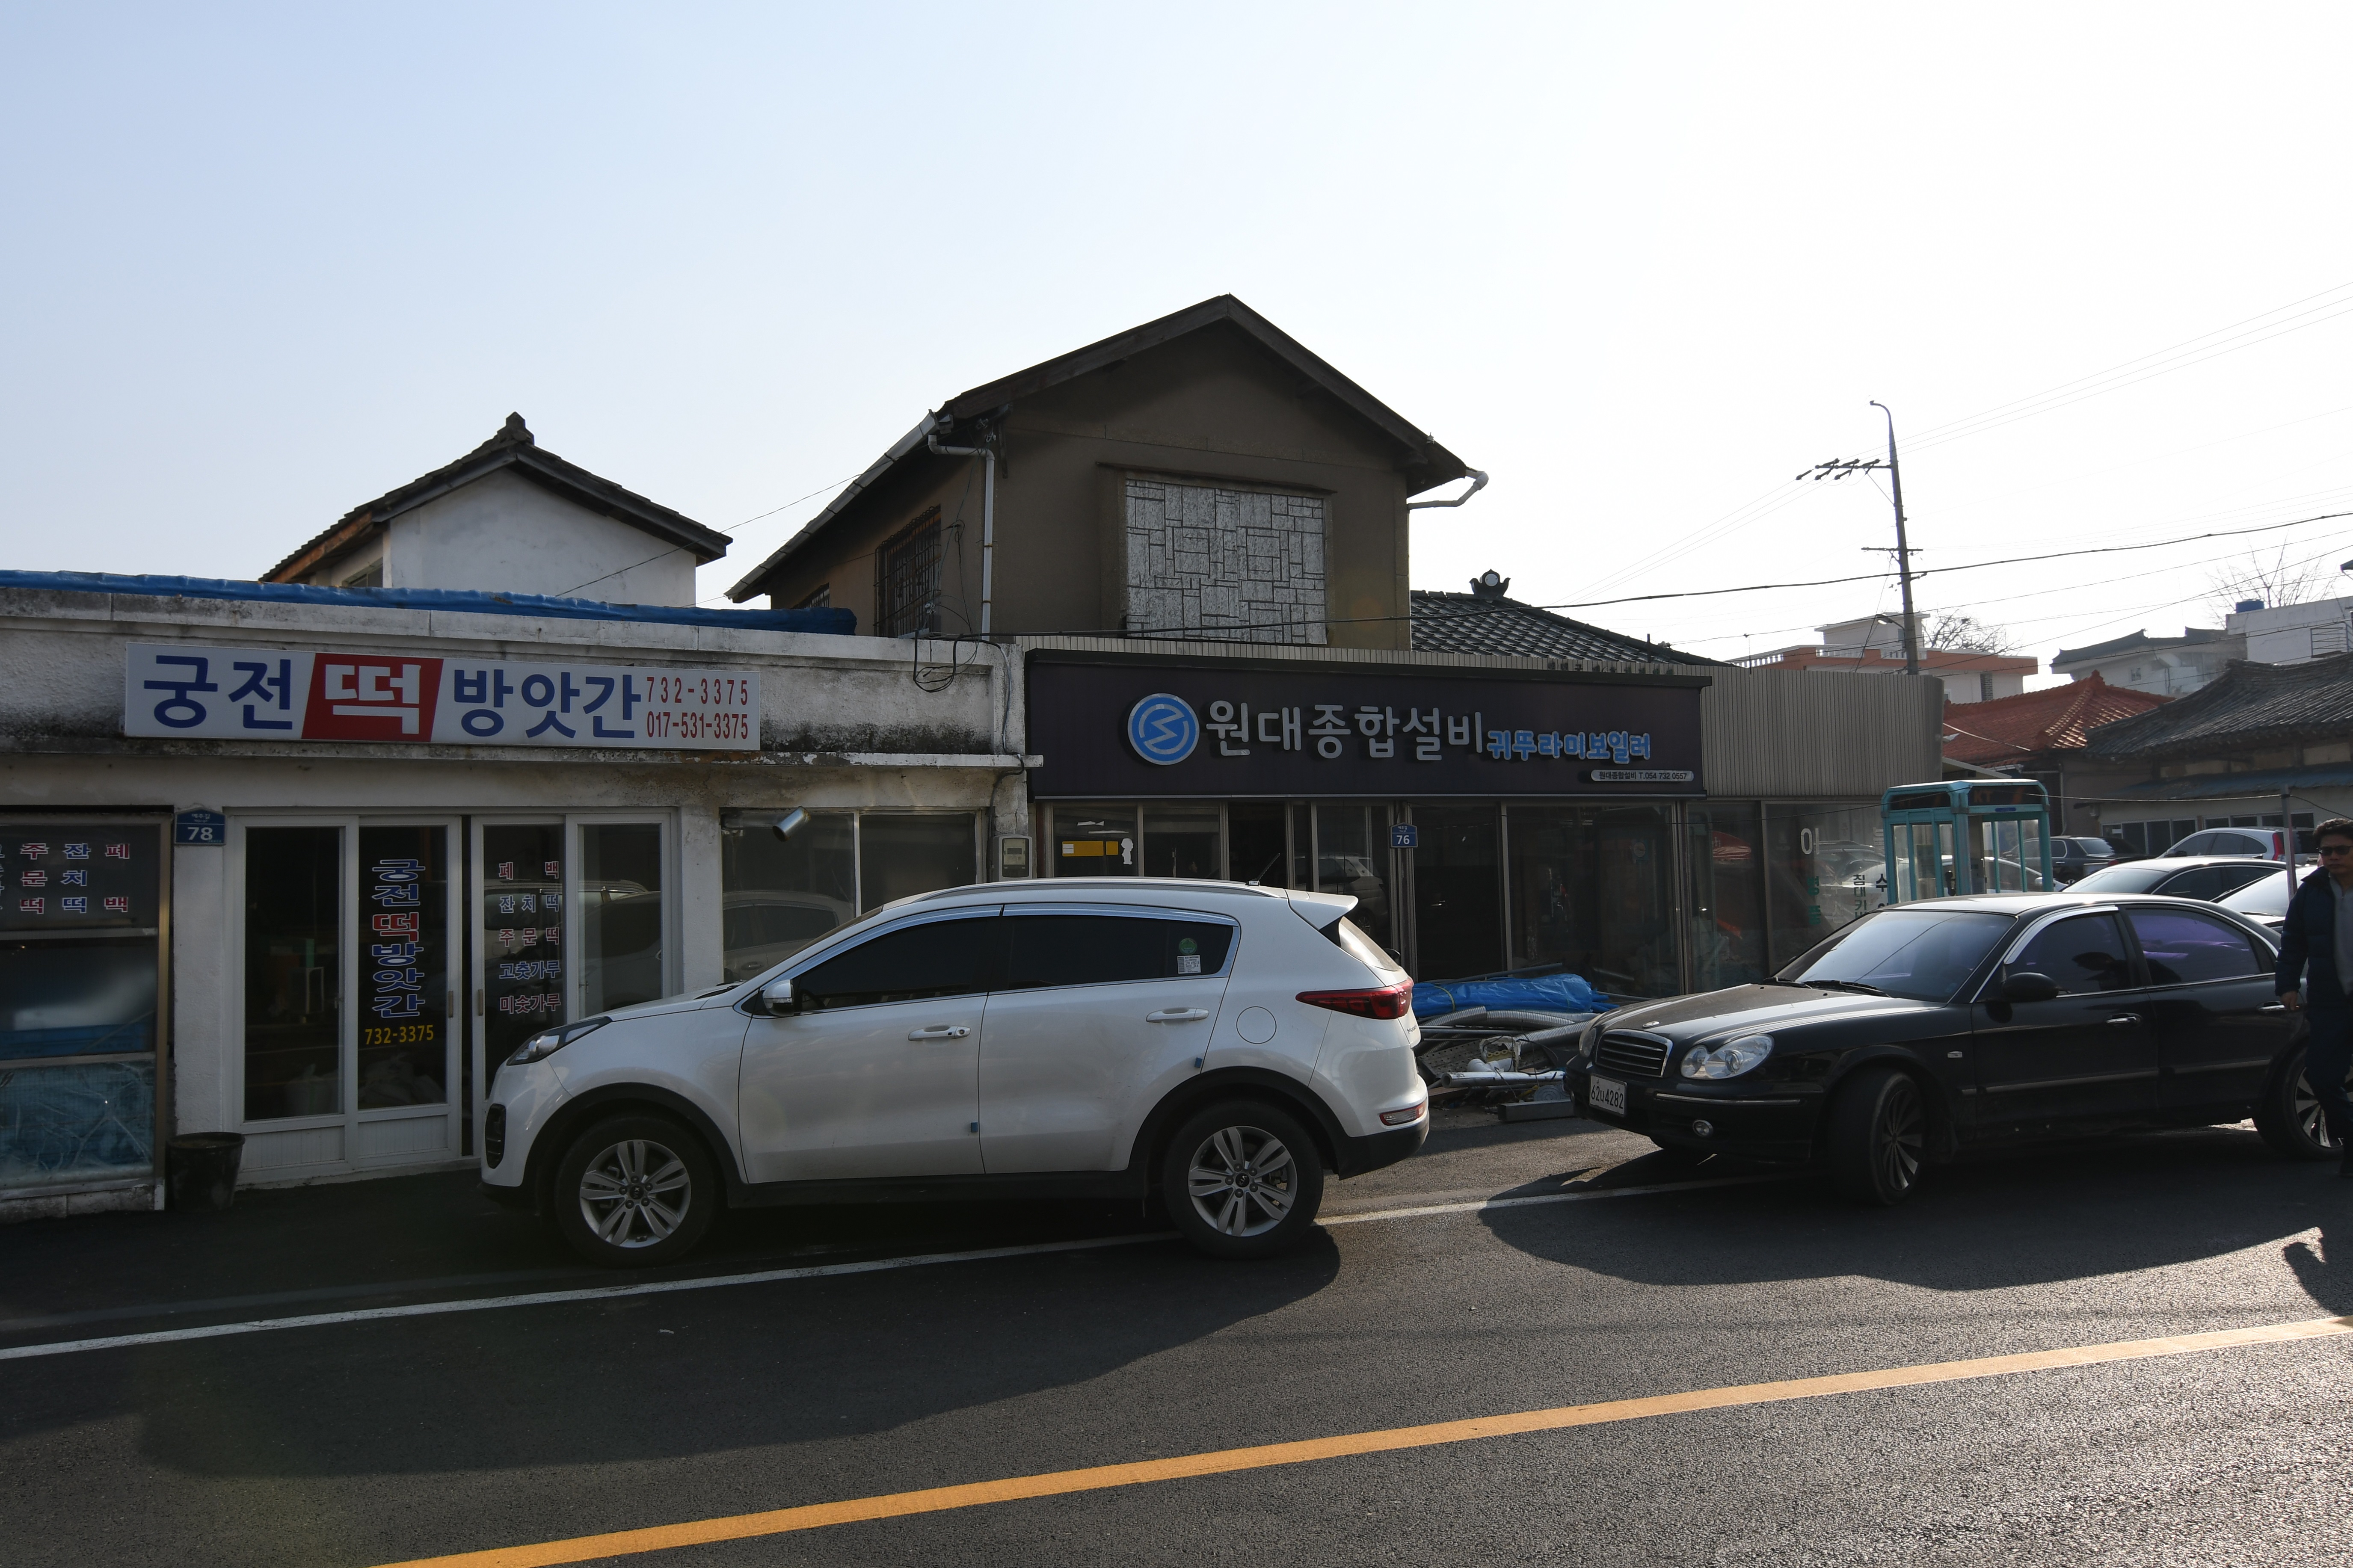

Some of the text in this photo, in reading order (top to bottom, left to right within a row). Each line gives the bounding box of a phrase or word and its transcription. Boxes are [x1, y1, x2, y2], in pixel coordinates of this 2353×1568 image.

[143, 654, 641, 739] 궁전 떡 방앗간
[646, 675, 749, 707] 732-3375
[646, 710, 749, 740] 017-531-3375
[1205, 698, 1484, 761] 원대종합설비
[1486, 729, 1651, 765] 귀뚜라미보일러
[187, 827, 213, 840] 78
[1396, 835, 1410, 845] 76
[499, 959, 561, 980] 고춧가루
[499, 993, 562, 1014] 미숫가루
[365, 1024, 434, 1045] 732-3375
